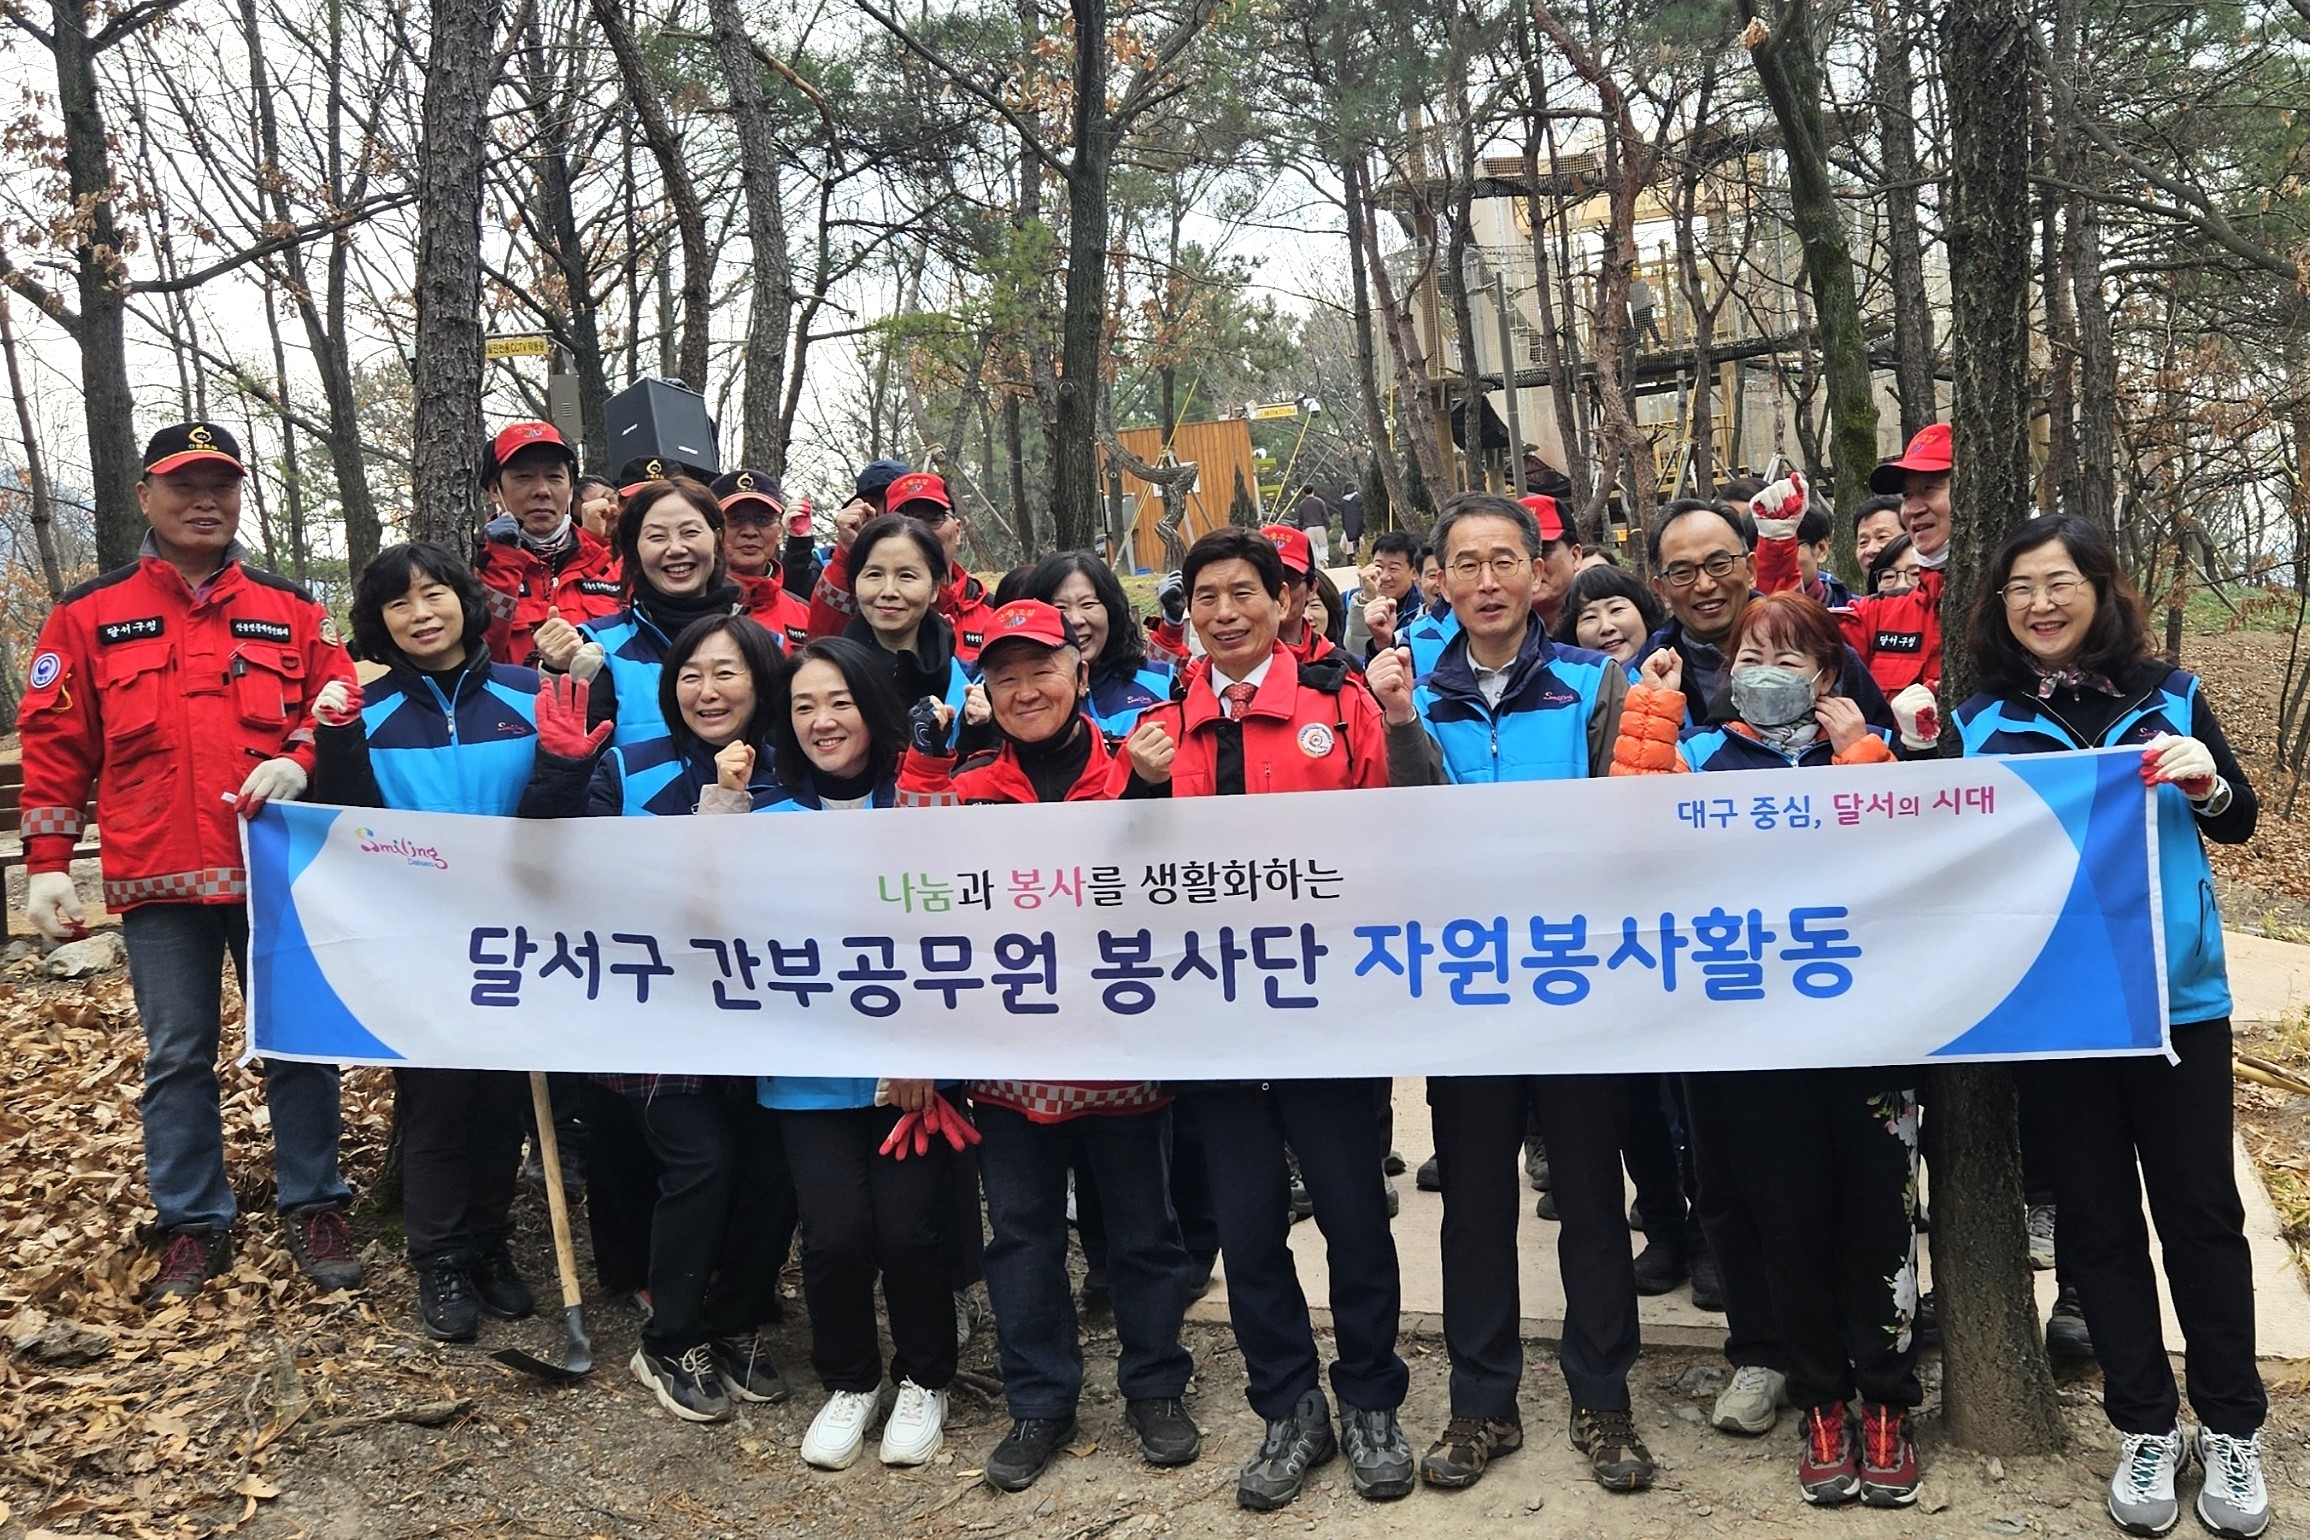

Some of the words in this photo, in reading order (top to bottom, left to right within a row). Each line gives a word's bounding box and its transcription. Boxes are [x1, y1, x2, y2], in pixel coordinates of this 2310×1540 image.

[106, 619, 156, 638] 달서구청
[1879, 634, 1916, 648] 달서구청
[1678, 799, 1738, 829] 대구
[1749, 795, 1822, 830] 중심,
[1833, 791, 1920, 826] 달서의
[1932, 785, 1995, 815] 시대
[878, 869, 995, 914] 나눔과
[1007, 865, 1127, 910] 봉사를
[1140, 857, 1344, 905] 생활화하는
[469, 925, 675, 1008] 달서구
[689, 929, 1060, 1018] 간부공무원
[1090, 921, 1329, 1016] 봉사단
[1353, 905, 1863, 1007] 자원봉사활동
